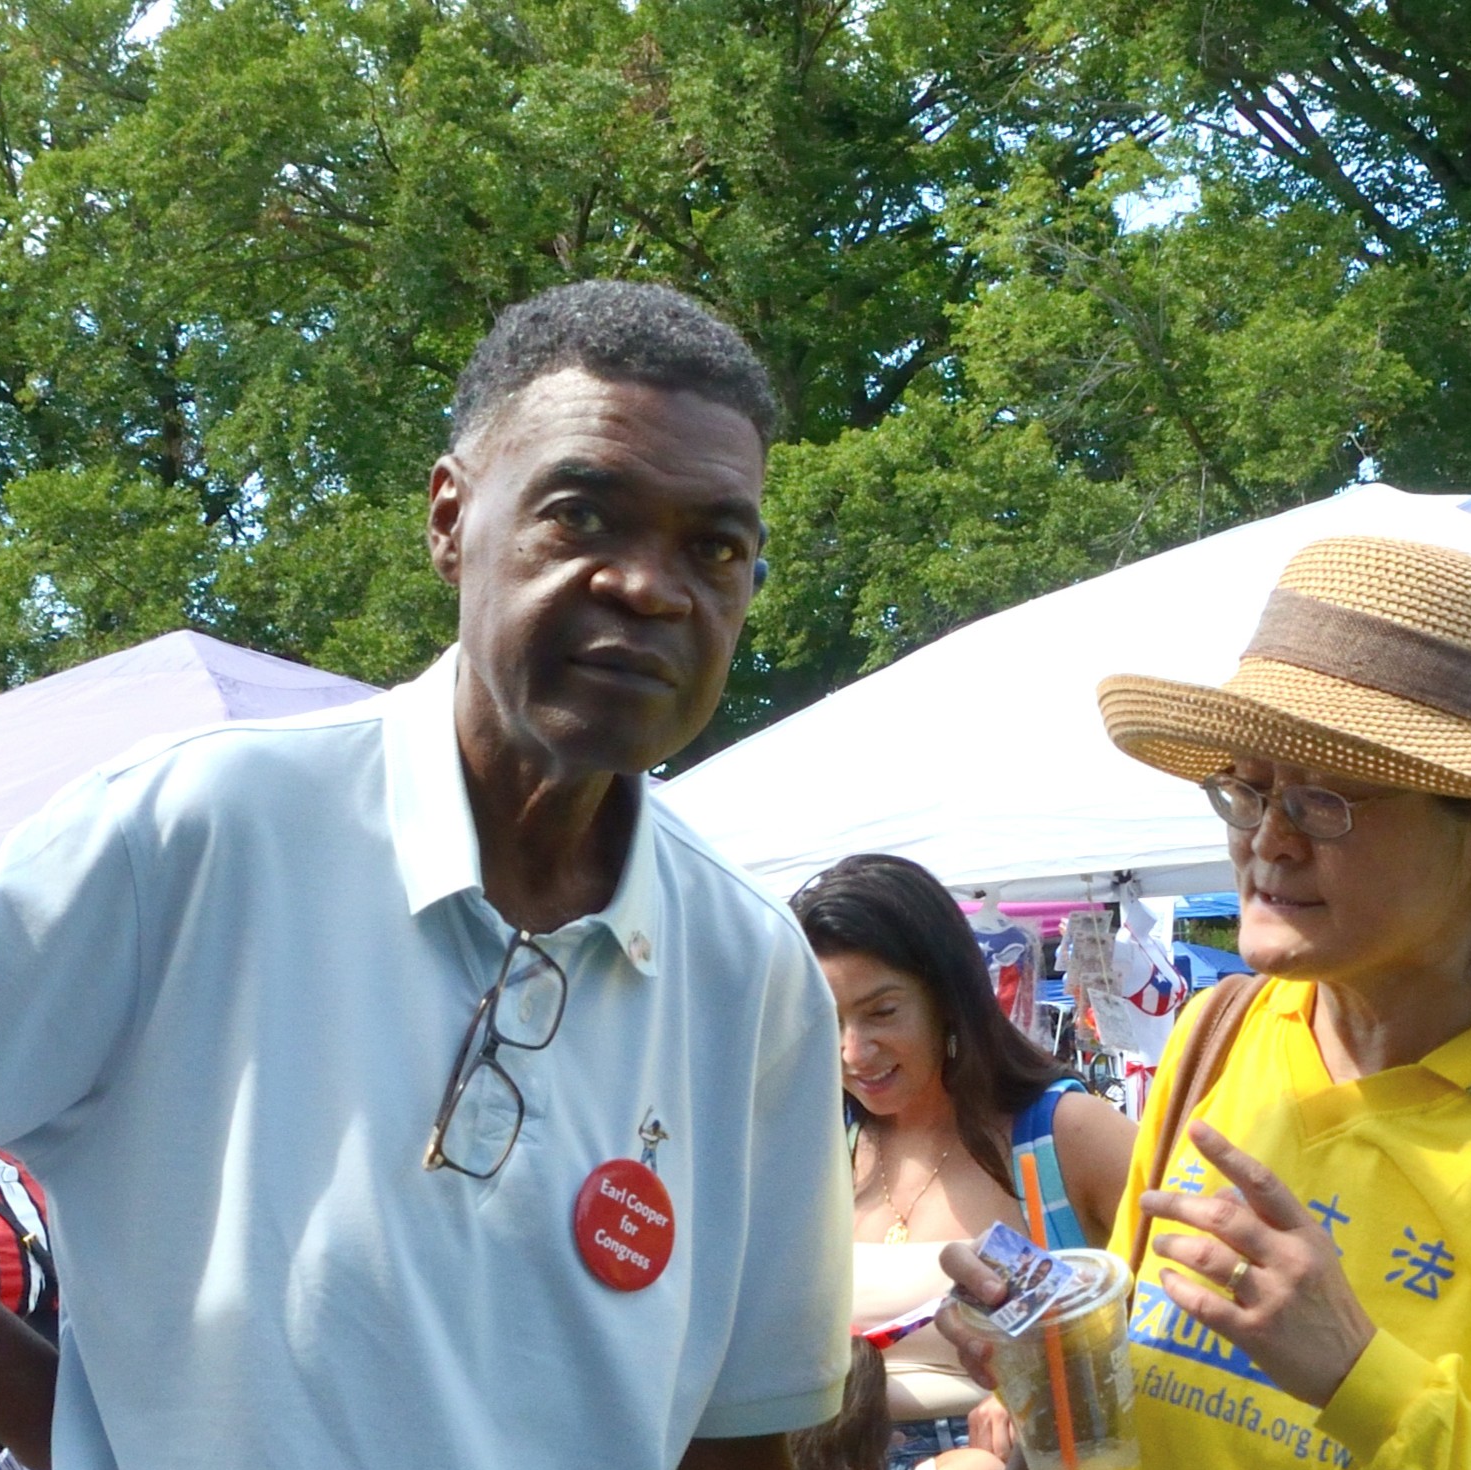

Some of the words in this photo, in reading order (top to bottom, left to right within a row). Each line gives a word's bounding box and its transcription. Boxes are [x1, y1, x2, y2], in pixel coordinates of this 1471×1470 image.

[600, 1178, 627, 1205] Earl
[626, 1193, 669, 1228] Cooper
[619, 1215, 639, 1237] for
[594, 1229, 650, 1270] Congress
